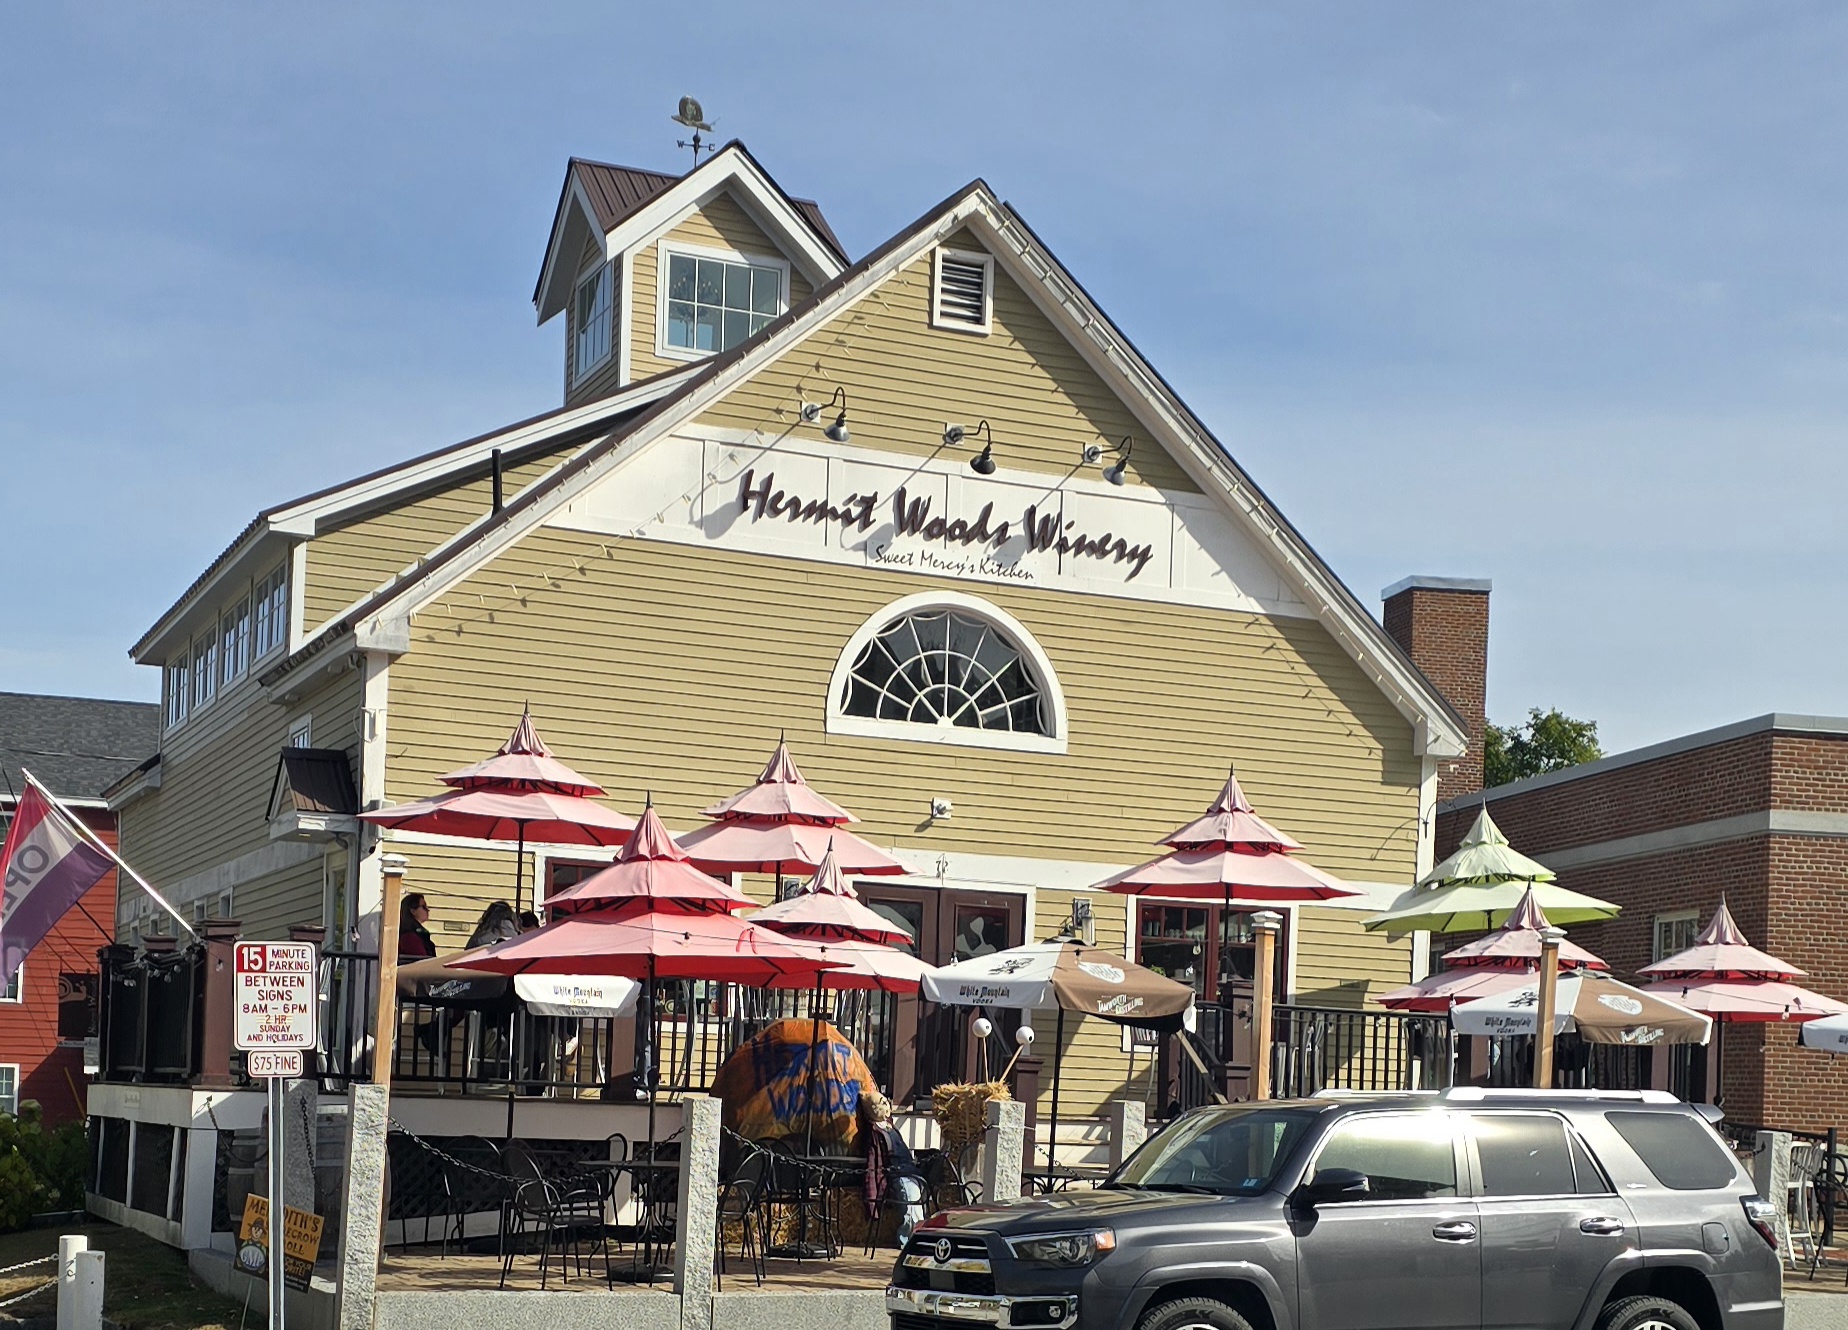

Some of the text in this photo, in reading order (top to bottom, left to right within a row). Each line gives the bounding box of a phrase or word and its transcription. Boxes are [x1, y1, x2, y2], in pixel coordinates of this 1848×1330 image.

[677, 140, 684, 148] W
[737, 468, 1153, 583] Hermit Woods Winery
[875, 544, 1034, 580] Sweet Mercy's Kitchen
[242, 946, 263, 971] 15
[271, 949, 307, 959] MINUTE
[269, 961, 310, 971] PARKING
[245, 976, 305, 987] BETWEEN
[257, 989, 293, 1001] SIGNS
[553, 986, 571, 997] White
[960, 985, 1010, 998] White Mountain
[265, 1014, 287, 1024] 2 HR
[266, 1034, 304, 1042] HOLIDAYS
[254, 1056, 297, 1071] $75 FINE
[247, 1198, 320, 1233] MEITH'S
